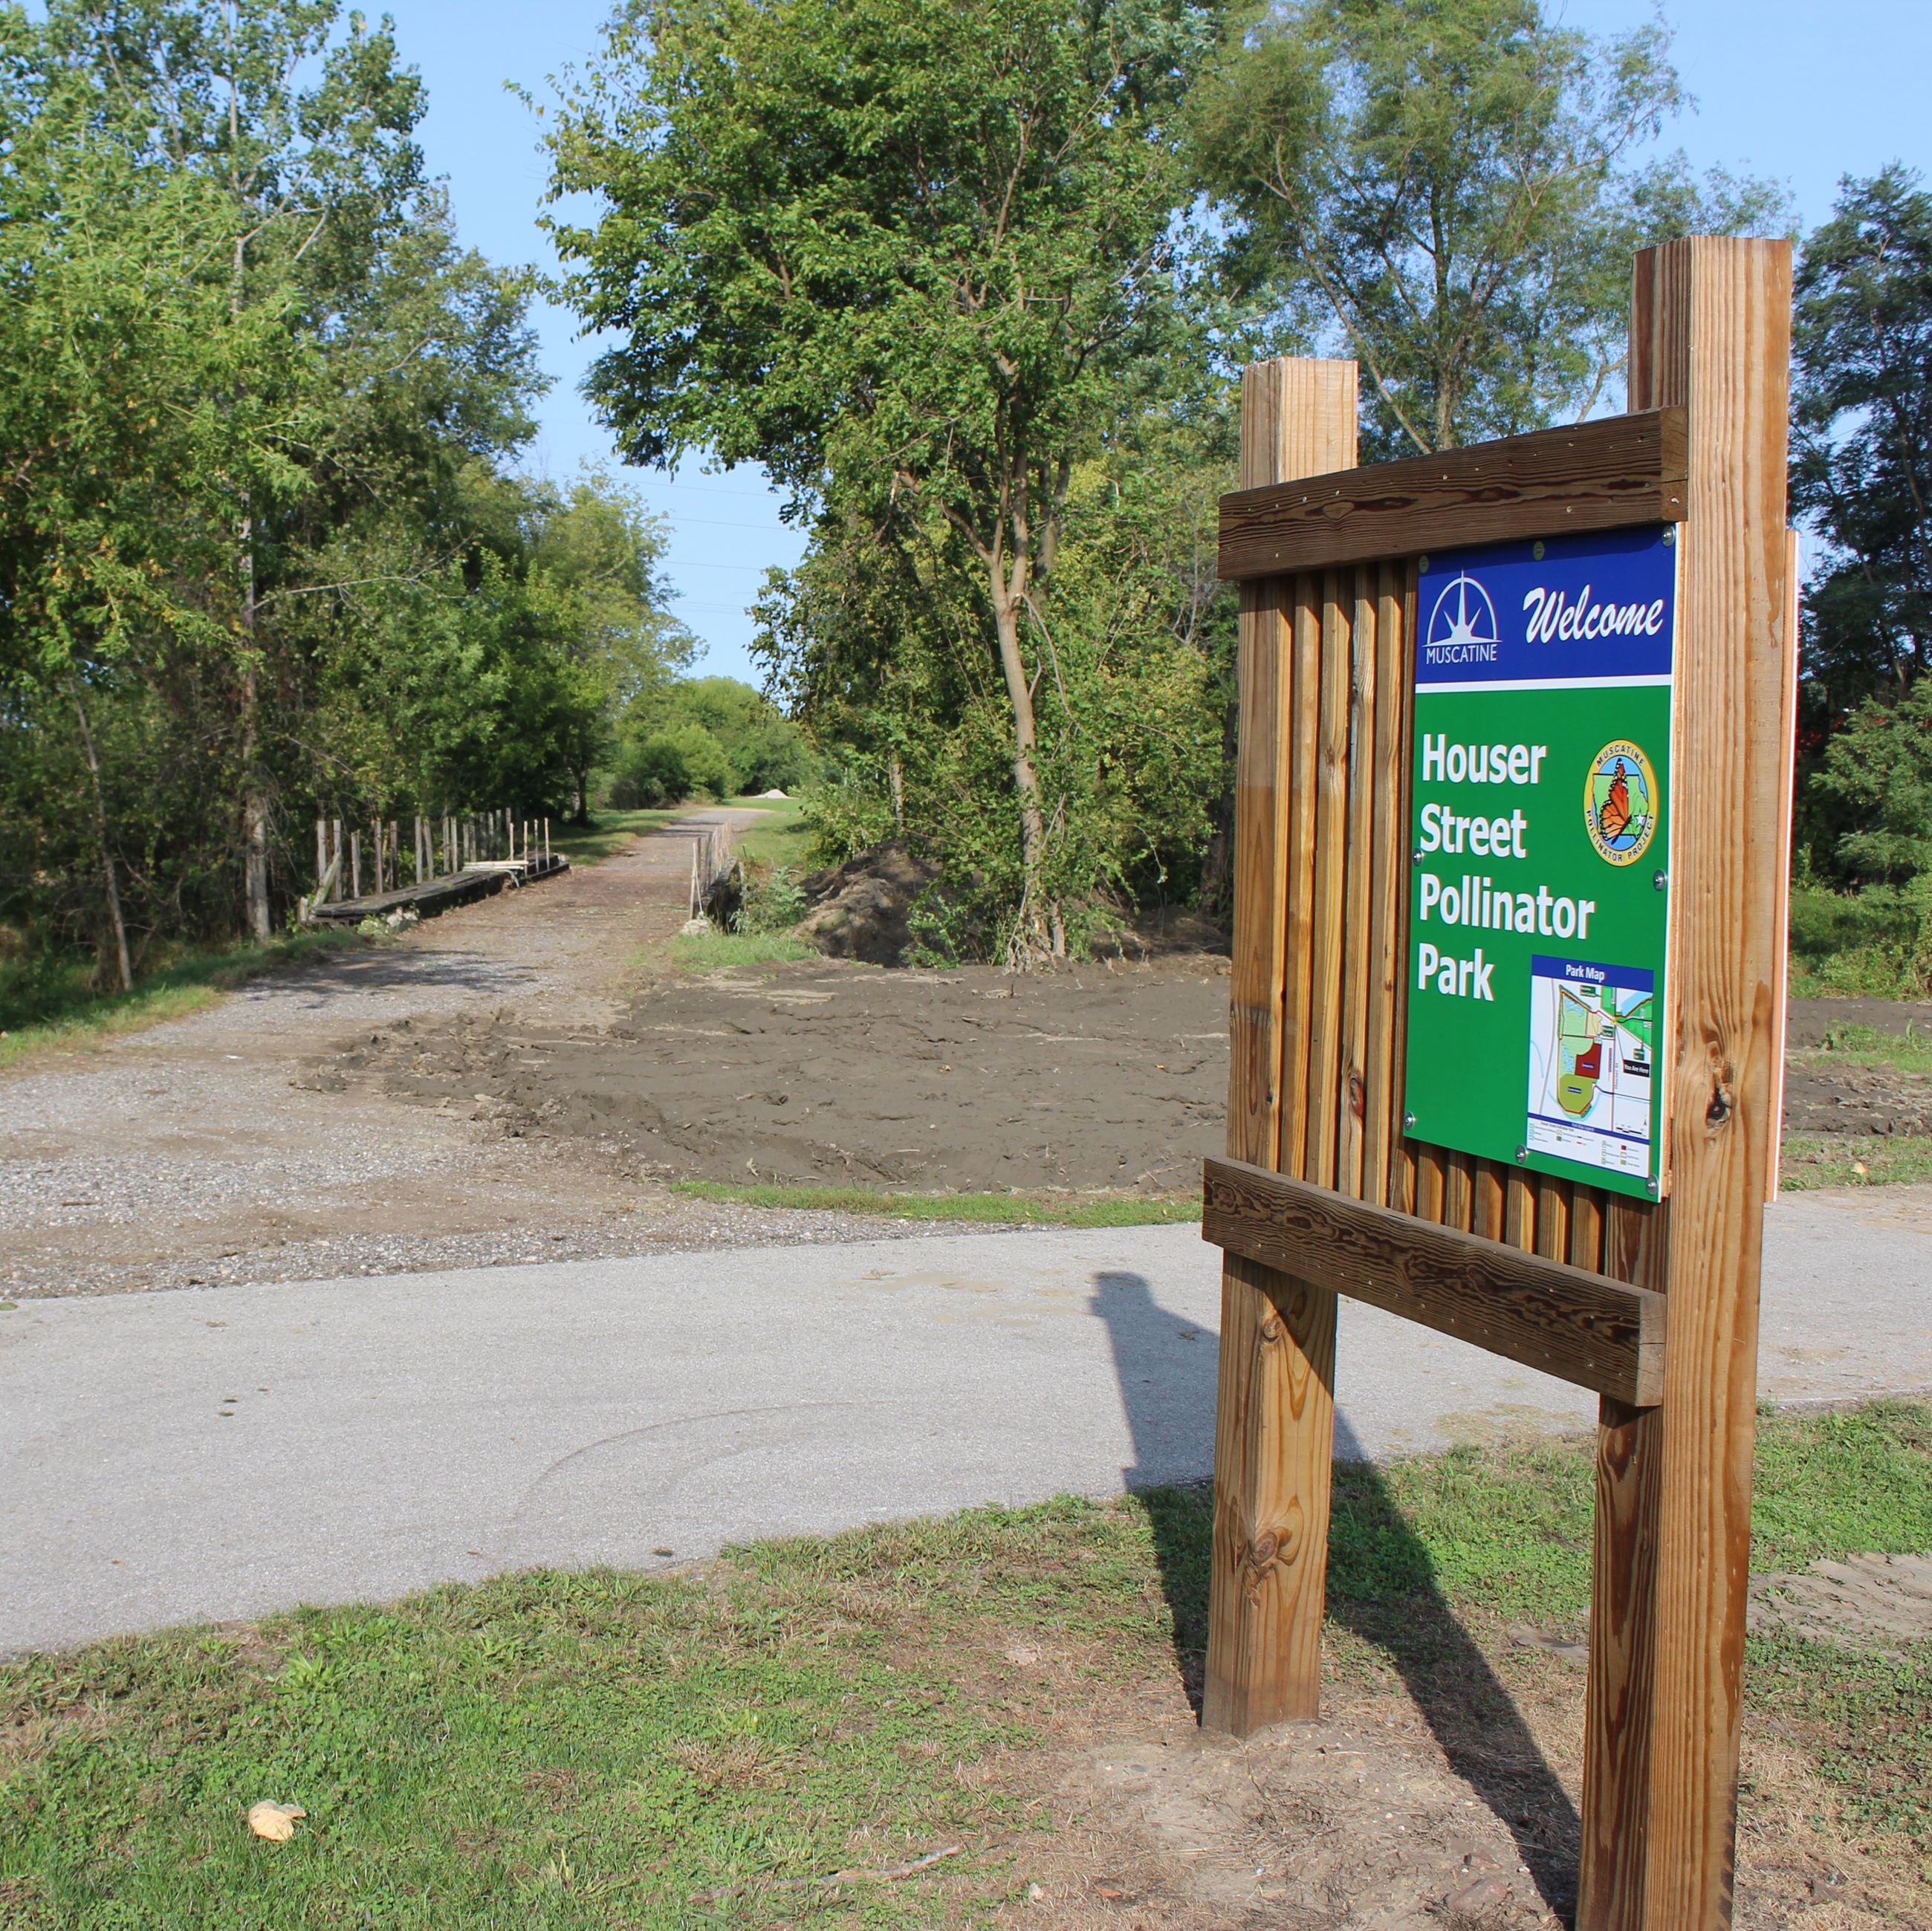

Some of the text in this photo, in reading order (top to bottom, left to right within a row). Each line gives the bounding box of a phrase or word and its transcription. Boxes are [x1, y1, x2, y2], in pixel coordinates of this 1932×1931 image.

[1523, 584, 1664, 645] Welcome
[1426, 643, 1498, 664] MUSCATINE
[1422, 733, 1547, 785] Houser
[1596, 744, 1645, 768] MUSCATINE
[1419, 802, 1528, 859] Street
[1586, 810, 1655, 863] POLLINATOR PROJECT
[1419, 872, 1595, 941] Pollinator
[1418, 942, 1495, 1002] Park
[1566, 964, 1605, 983] Park Map
